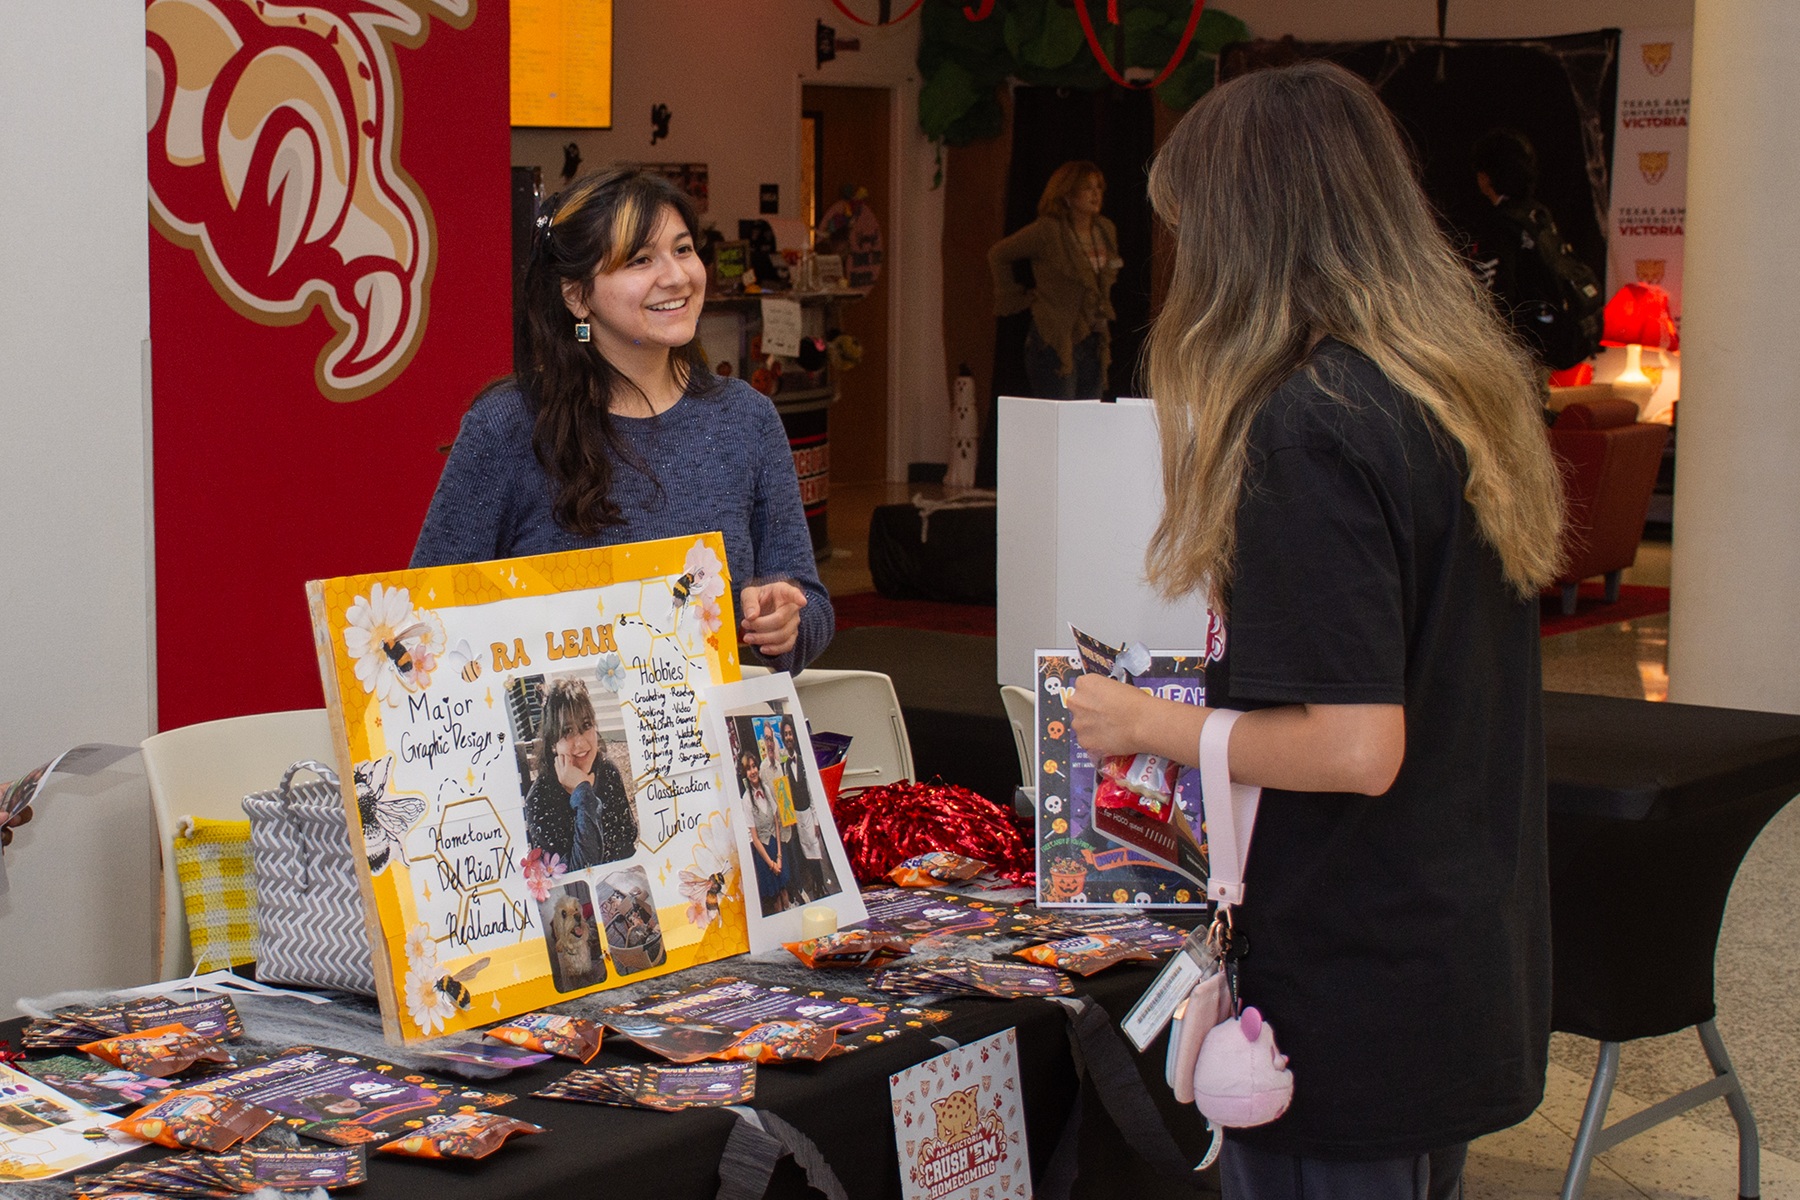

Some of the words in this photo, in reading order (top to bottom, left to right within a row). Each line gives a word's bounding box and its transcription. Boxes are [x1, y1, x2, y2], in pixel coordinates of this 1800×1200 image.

[1623, 99, 1659, 107] TEXAS
[1622, 108, 1687, 117] UNIVERSITY
[1623, 117, 1687, 128] VICTORIA
[1620, 207, 1656, 215] TEXAS
[1619, 216, 1684, 224] UNIVERSITY
[1620, 225, 1684, 235] VICTORIA
[490, 638, 531, 672] RA
[545, 624, 617, 661] LEAH
[632, 656, 684, 685] Hobbies
[408, 692, 473, 733] Major
[637, 705, 664, 720] Cooking
[674, 702, 691, 713] Video
[676, 715, 697, 724] Games
[401, 730, 450, 770] Graphic
[452, 723, 492, 764] Design
[642, 734, 669, 748] Painting
[644, 749, 673, 764] Drawing
[647, 776, 711, 800] Classification
[654, 808, 702, 842] Junior
[1112, 813, 1129, 826] HOCO
[429, 823, 502, 852] Hometown
[437, 859, 463, 891] Del
[490, 847, 516, 879] TX
[472, 886, 480, 905] &
[513, 899, 535, 931] CA
[925, 1150, 969, 1186] CRUSH
[931, 1160, 996, 1199] HOMECOMING
